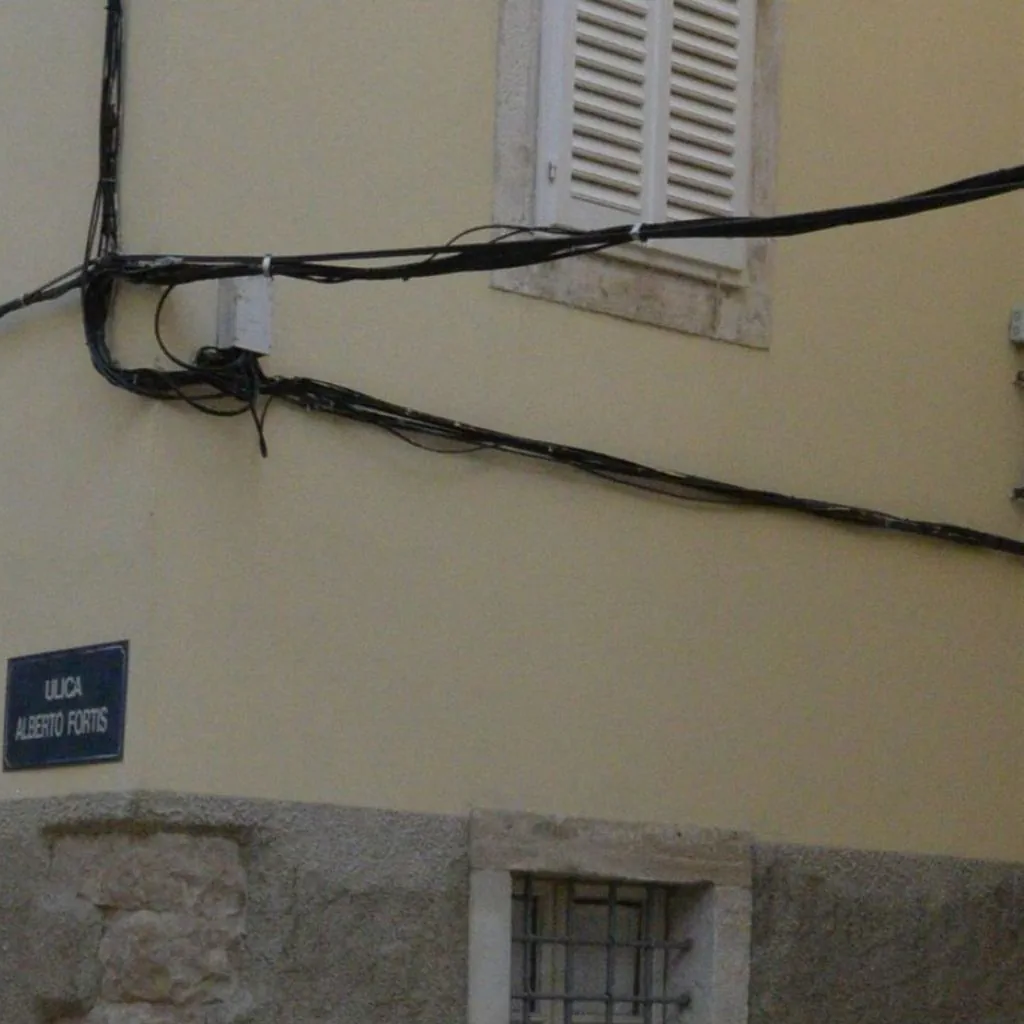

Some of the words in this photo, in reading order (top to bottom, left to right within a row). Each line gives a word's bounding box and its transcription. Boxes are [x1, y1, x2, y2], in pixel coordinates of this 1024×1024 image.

[43, 675, 83, 701] ULICA
[15, 710, 65, 741] ALBERTO
[67, 706, 109, 736] FORTIS
